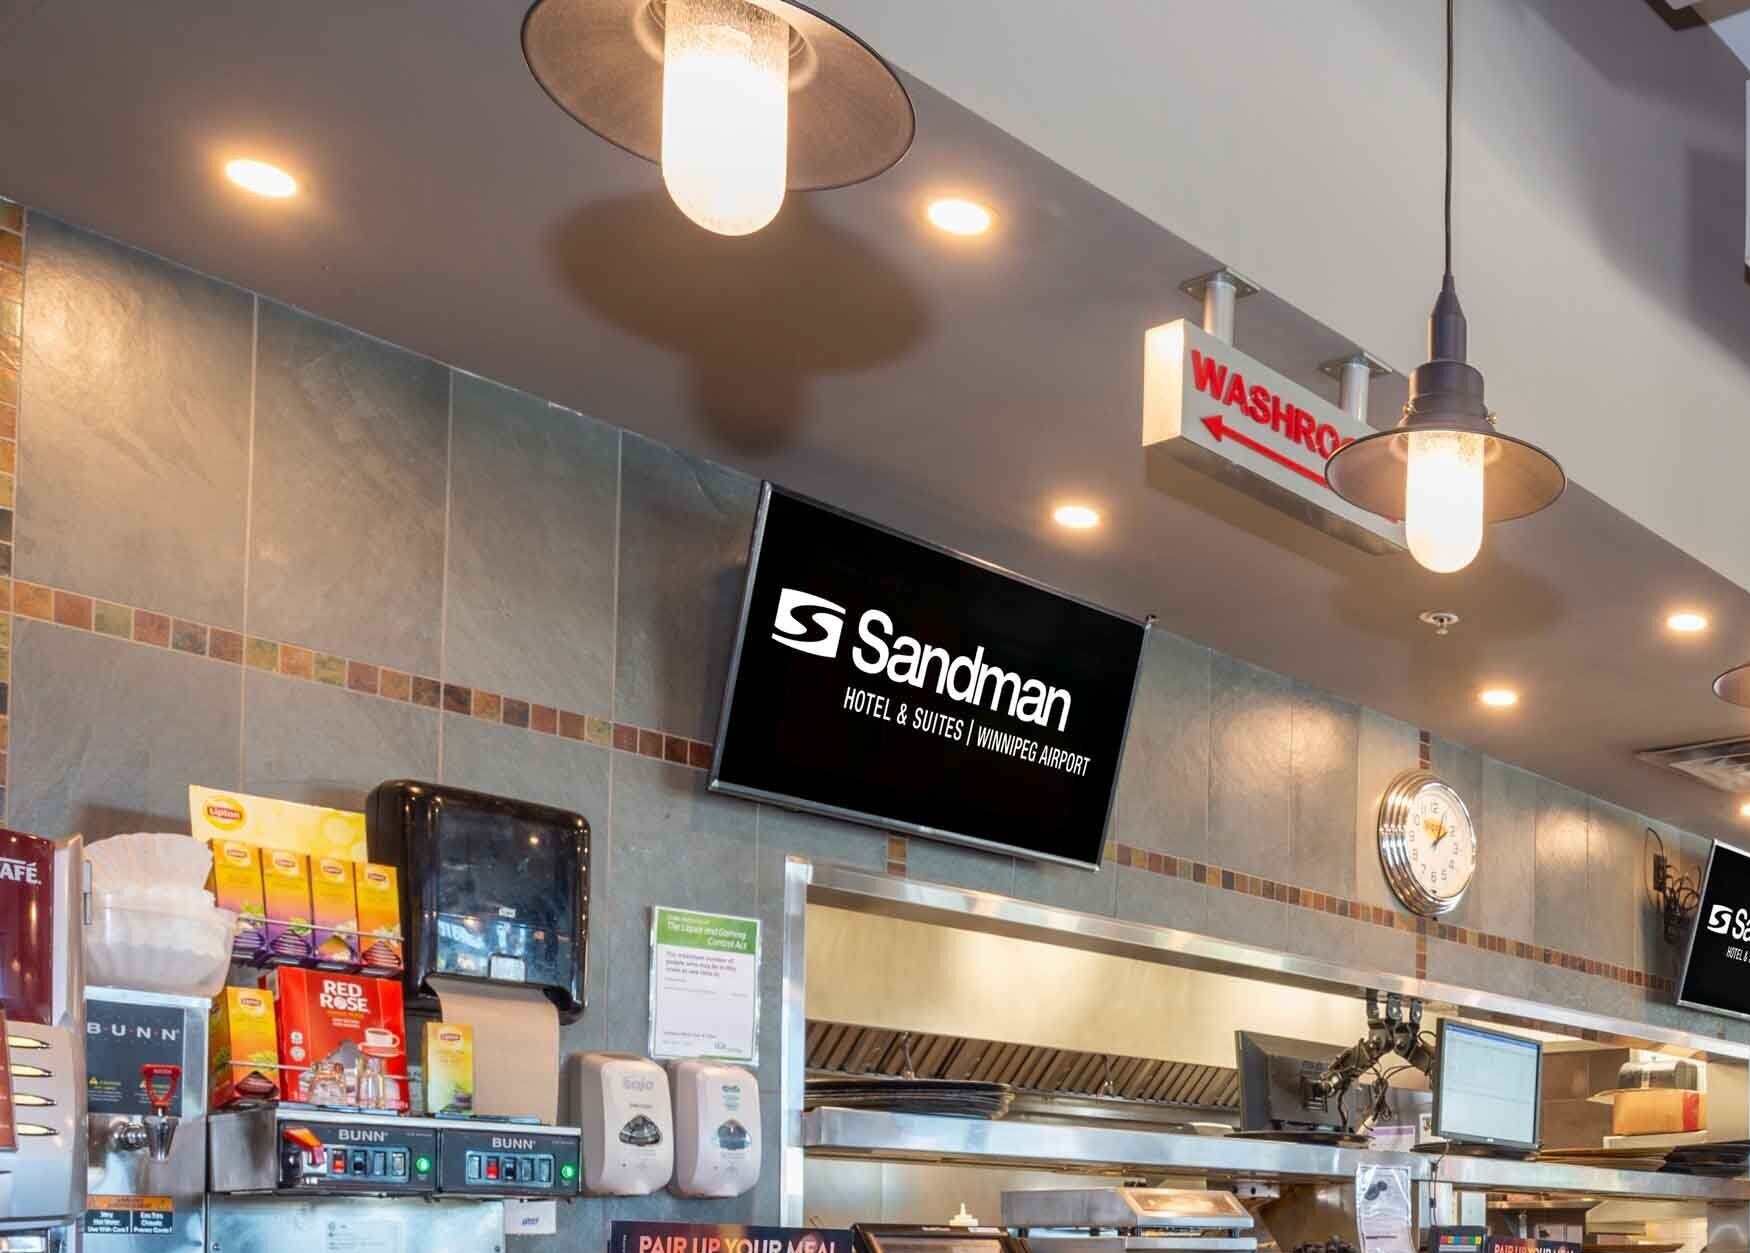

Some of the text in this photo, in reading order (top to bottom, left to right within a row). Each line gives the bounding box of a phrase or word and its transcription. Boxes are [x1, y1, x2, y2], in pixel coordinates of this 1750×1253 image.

[852, 608, 1072, 732] Sandman
[843, 686, 1091, 777] HOTEL & SUITES WINNIPEG AIRPORT
[209, 807, 242, 820] Lipton
[1726, 945, 1743, 961] HOTEL
[1743, 950, 1749, 962] &
[323, 979, 362, 997] RED
[319, 993, 370, 1013] ROSE
[338, 1128, 386, 1143] BUNN
[492, 1136, 535, 1150] BUNN
